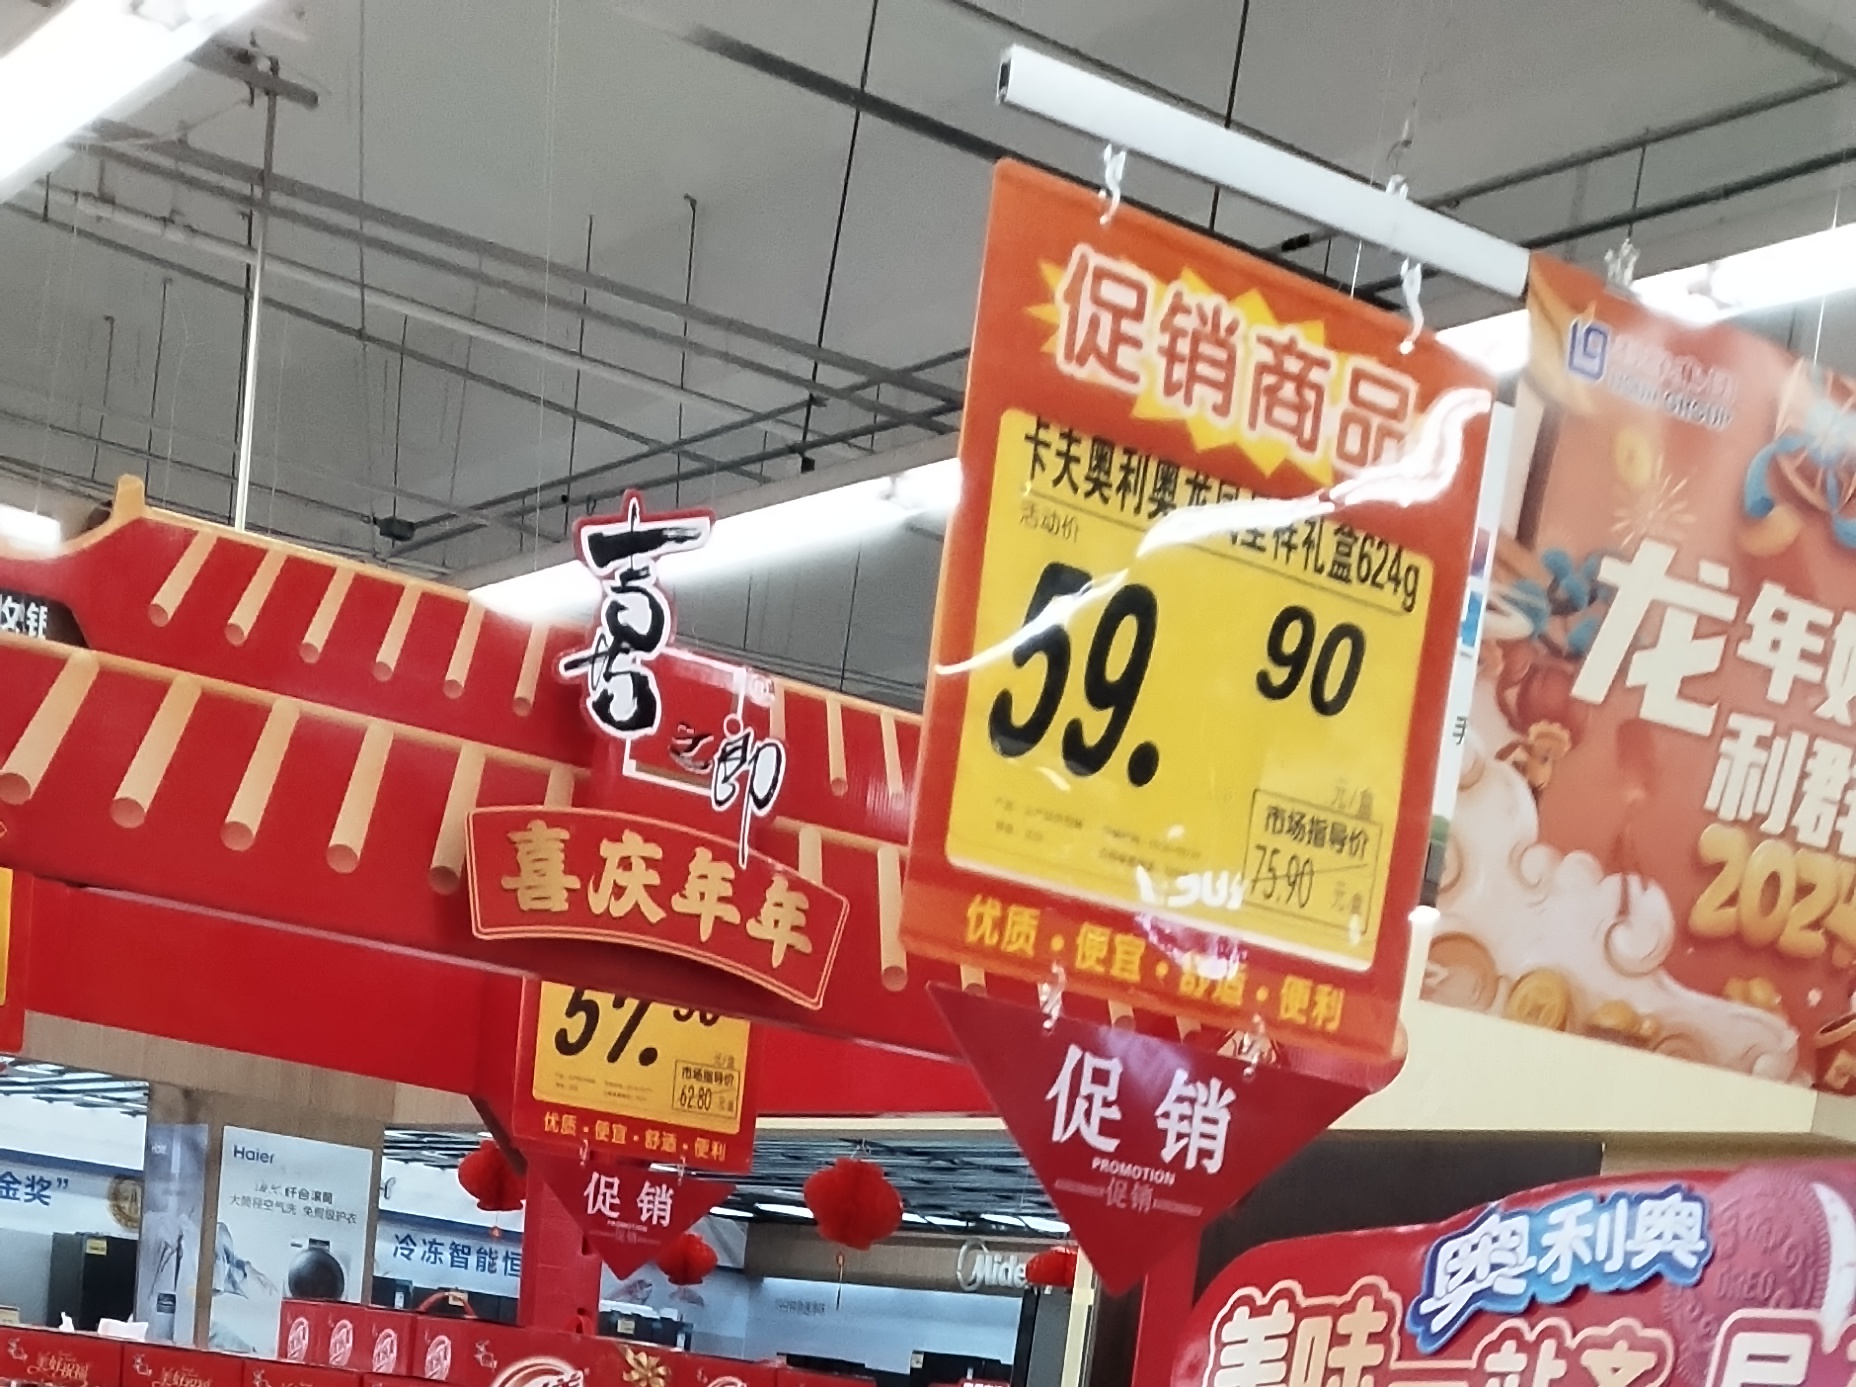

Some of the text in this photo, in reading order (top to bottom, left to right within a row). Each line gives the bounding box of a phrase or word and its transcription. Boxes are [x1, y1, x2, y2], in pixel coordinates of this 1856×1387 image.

[1060, 248, 1420, 474] 促销商品
[1020, 502, 1080, 544] 活动价
[1255, 603, 1366, 717] 90
[1264, 805, 1369, 859] 市场指导价
[502, 820, 814, 970] 喜庆年年
[1249, 844, 1315, 909] 75.90
[679, 1085, 713, 1113] 62.80
[1046, 1042, 1239, 1174] 促销
[233, 1145, 275, 1164] Haier
[1090, 1155, 1176, 1186] PROMOTION
[584, 1171, 675, 1228] 促销
[956, 1238, 1050, 1294] Mide
[1419, 1192, 1709, 1335] 奥利奥
